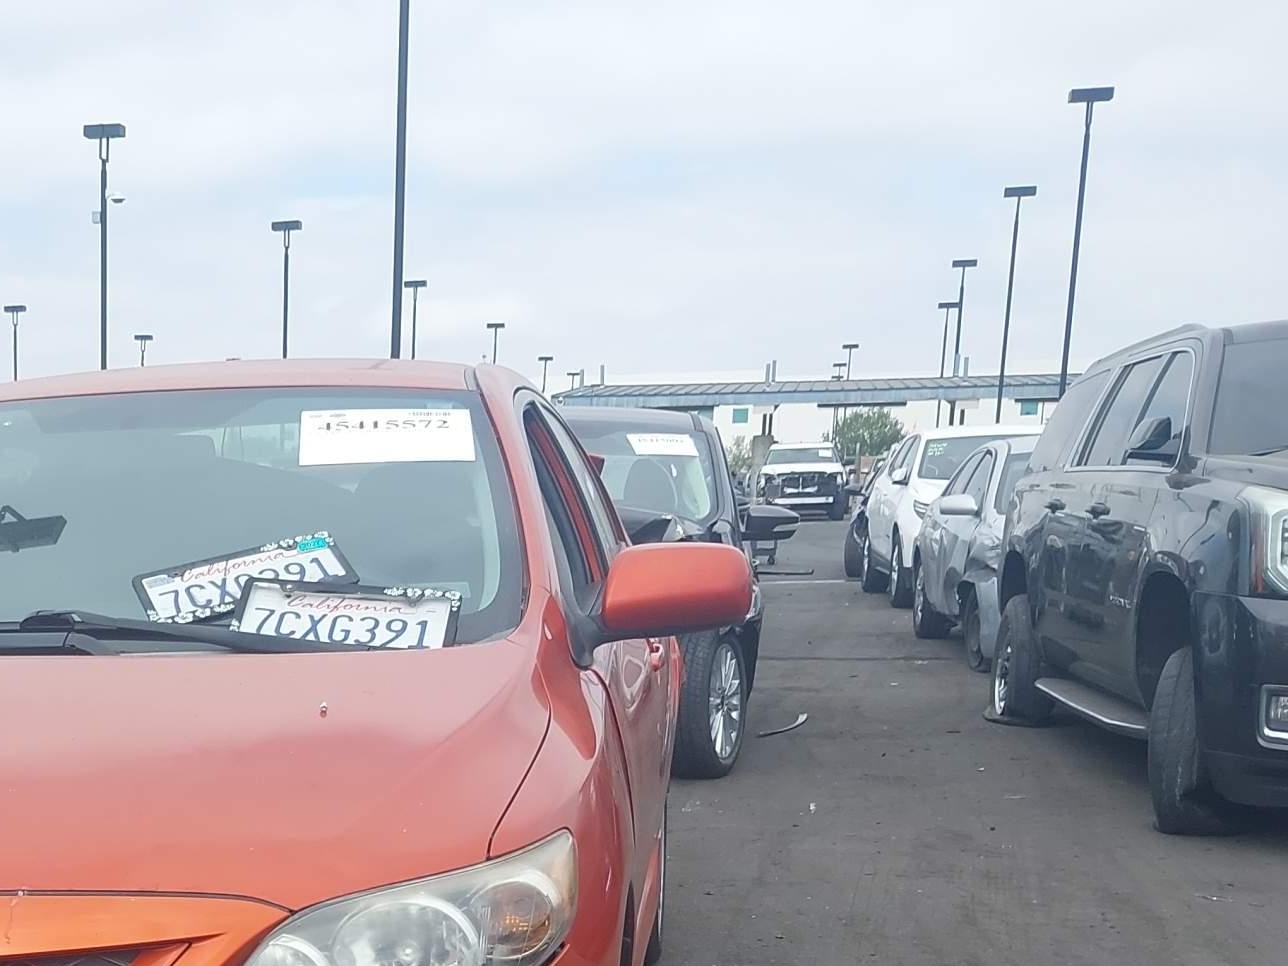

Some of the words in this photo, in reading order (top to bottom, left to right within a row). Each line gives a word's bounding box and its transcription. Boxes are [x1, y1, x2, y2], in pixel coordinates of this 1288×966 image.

[317, 419, 450, 431] 45415572
[181, 551, 296, 583] California
[286, 594, 410, 615] California
[254, 607, 431, 650] 7CXG391
